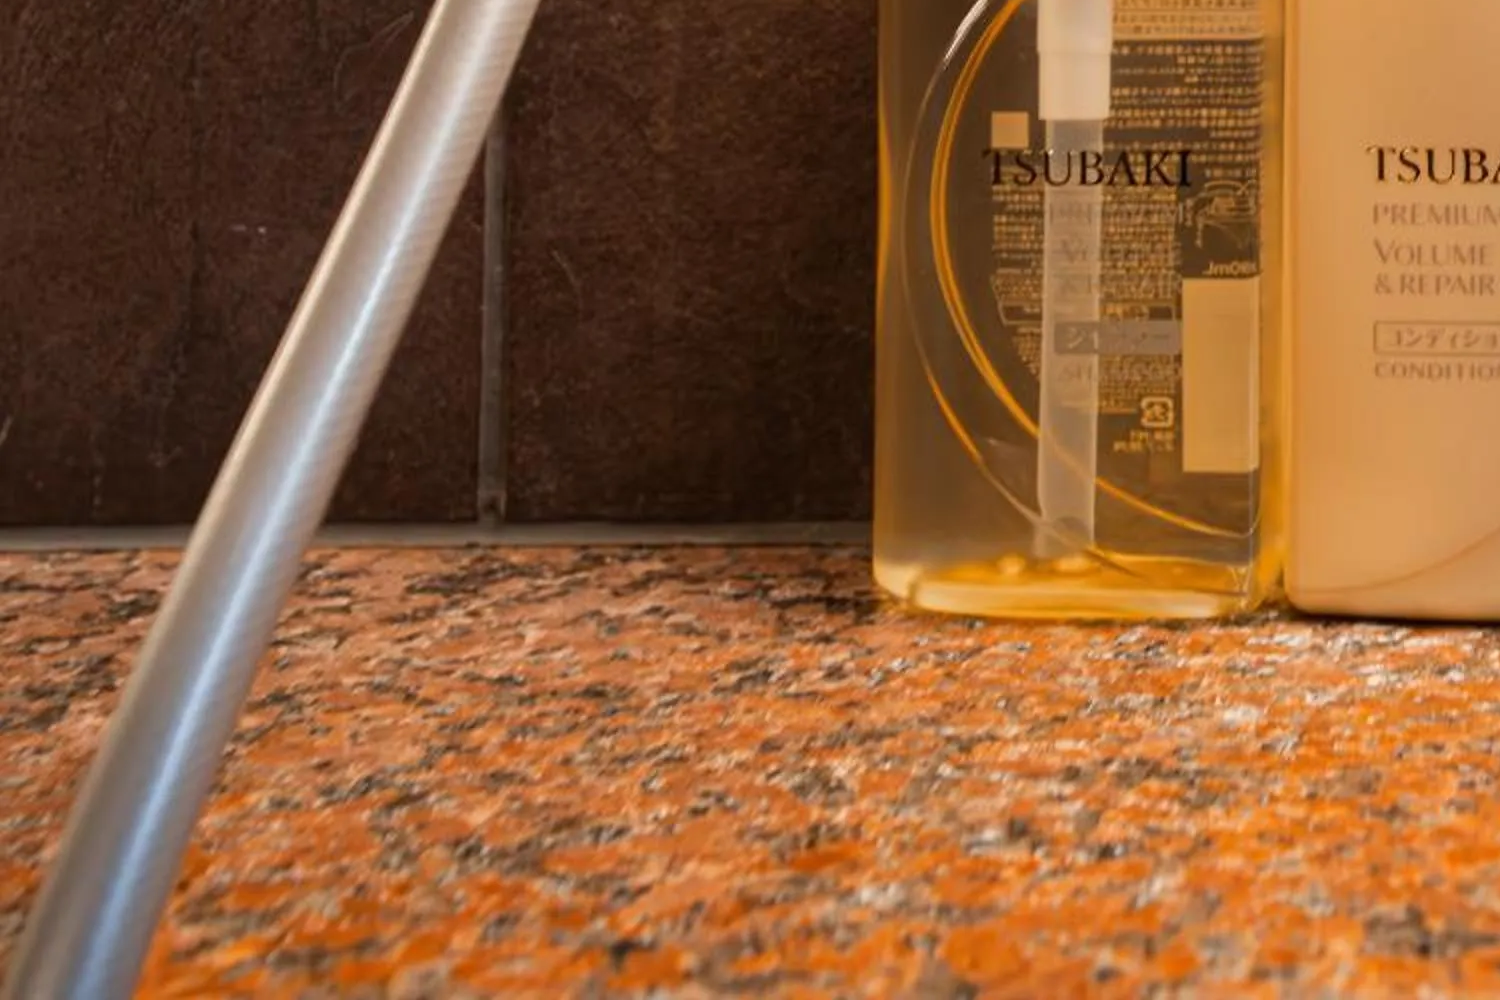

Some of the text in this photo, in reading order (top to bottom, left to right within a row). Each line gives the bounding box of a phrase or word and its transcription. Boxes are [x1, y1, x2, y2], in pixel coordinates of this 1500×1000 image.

[982, 149, 1194, 187] TSUBAKI
[1373, 237, 1493, 266] VOLUME
[1374, 273, 1496, 296] & REPAIR
